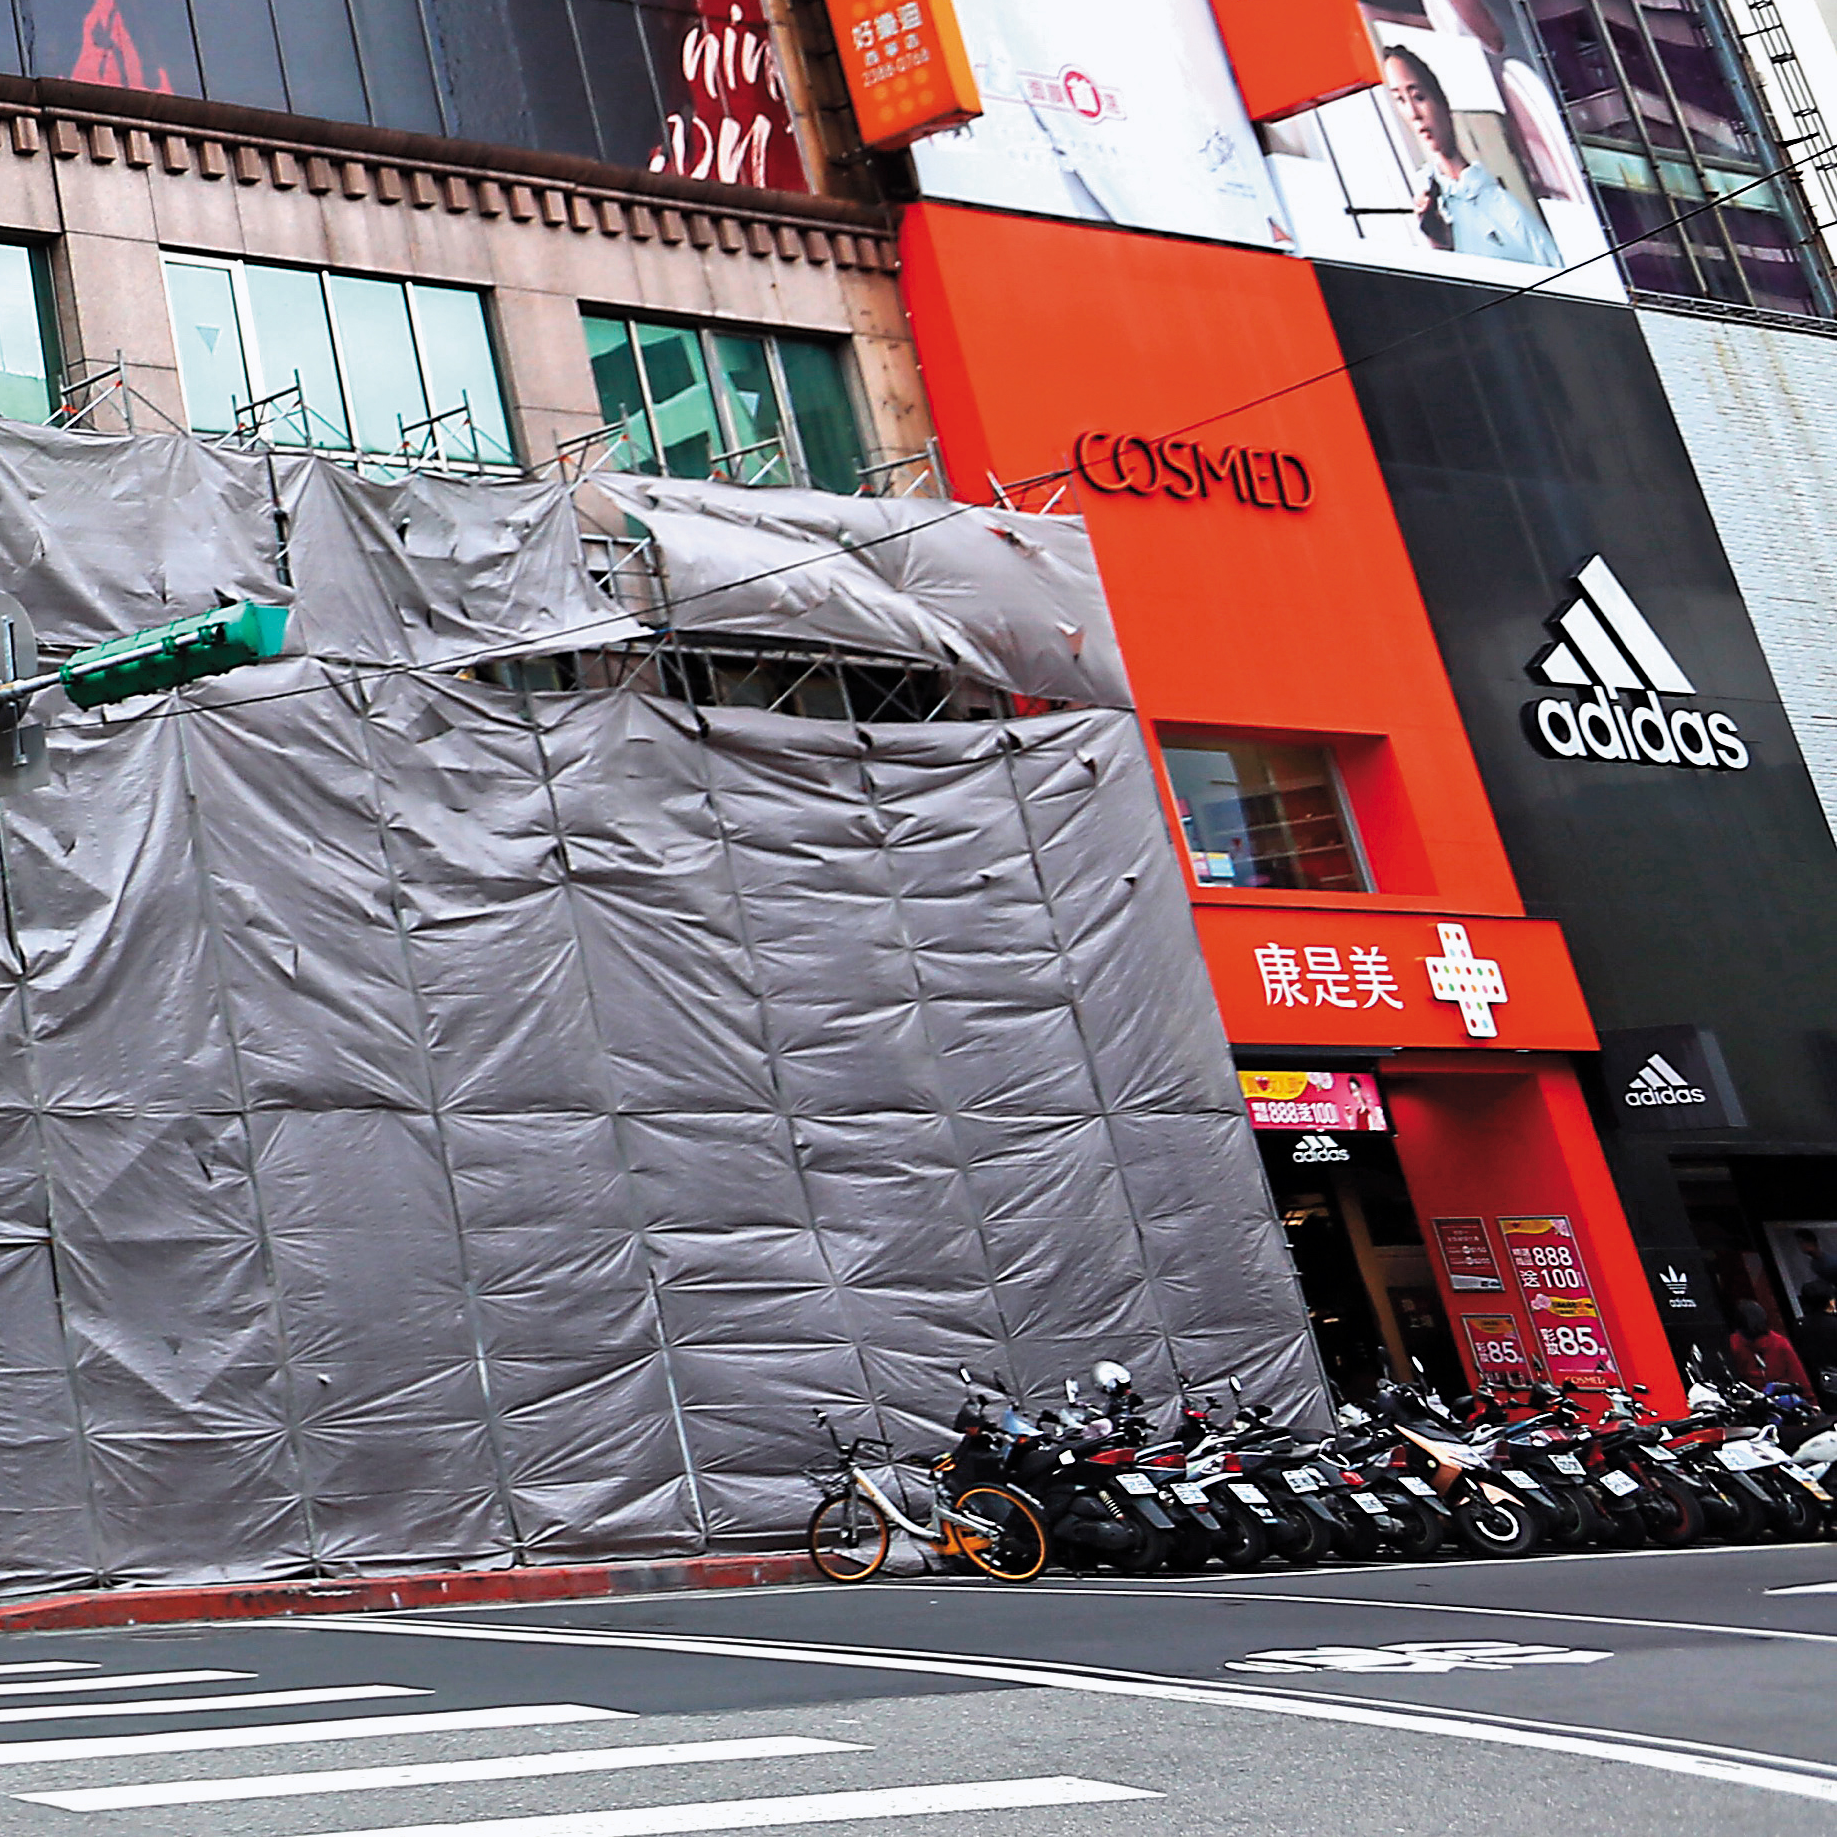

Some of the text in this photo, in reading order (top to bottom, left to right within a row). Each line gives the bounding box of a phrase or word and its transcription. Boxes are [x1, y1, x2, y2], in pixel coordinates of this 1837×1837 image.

[1074, 430, 1315, 513] COSMED
[1538, 684, 1750, 771] adidas
[1254, 942, 1405, 1011] 康是美
[1625, 1080, 1706, 1107] adidas
[1292, 1149, 1351, 1163] adidas
[1532, 1246, 1573, 1267] 888
